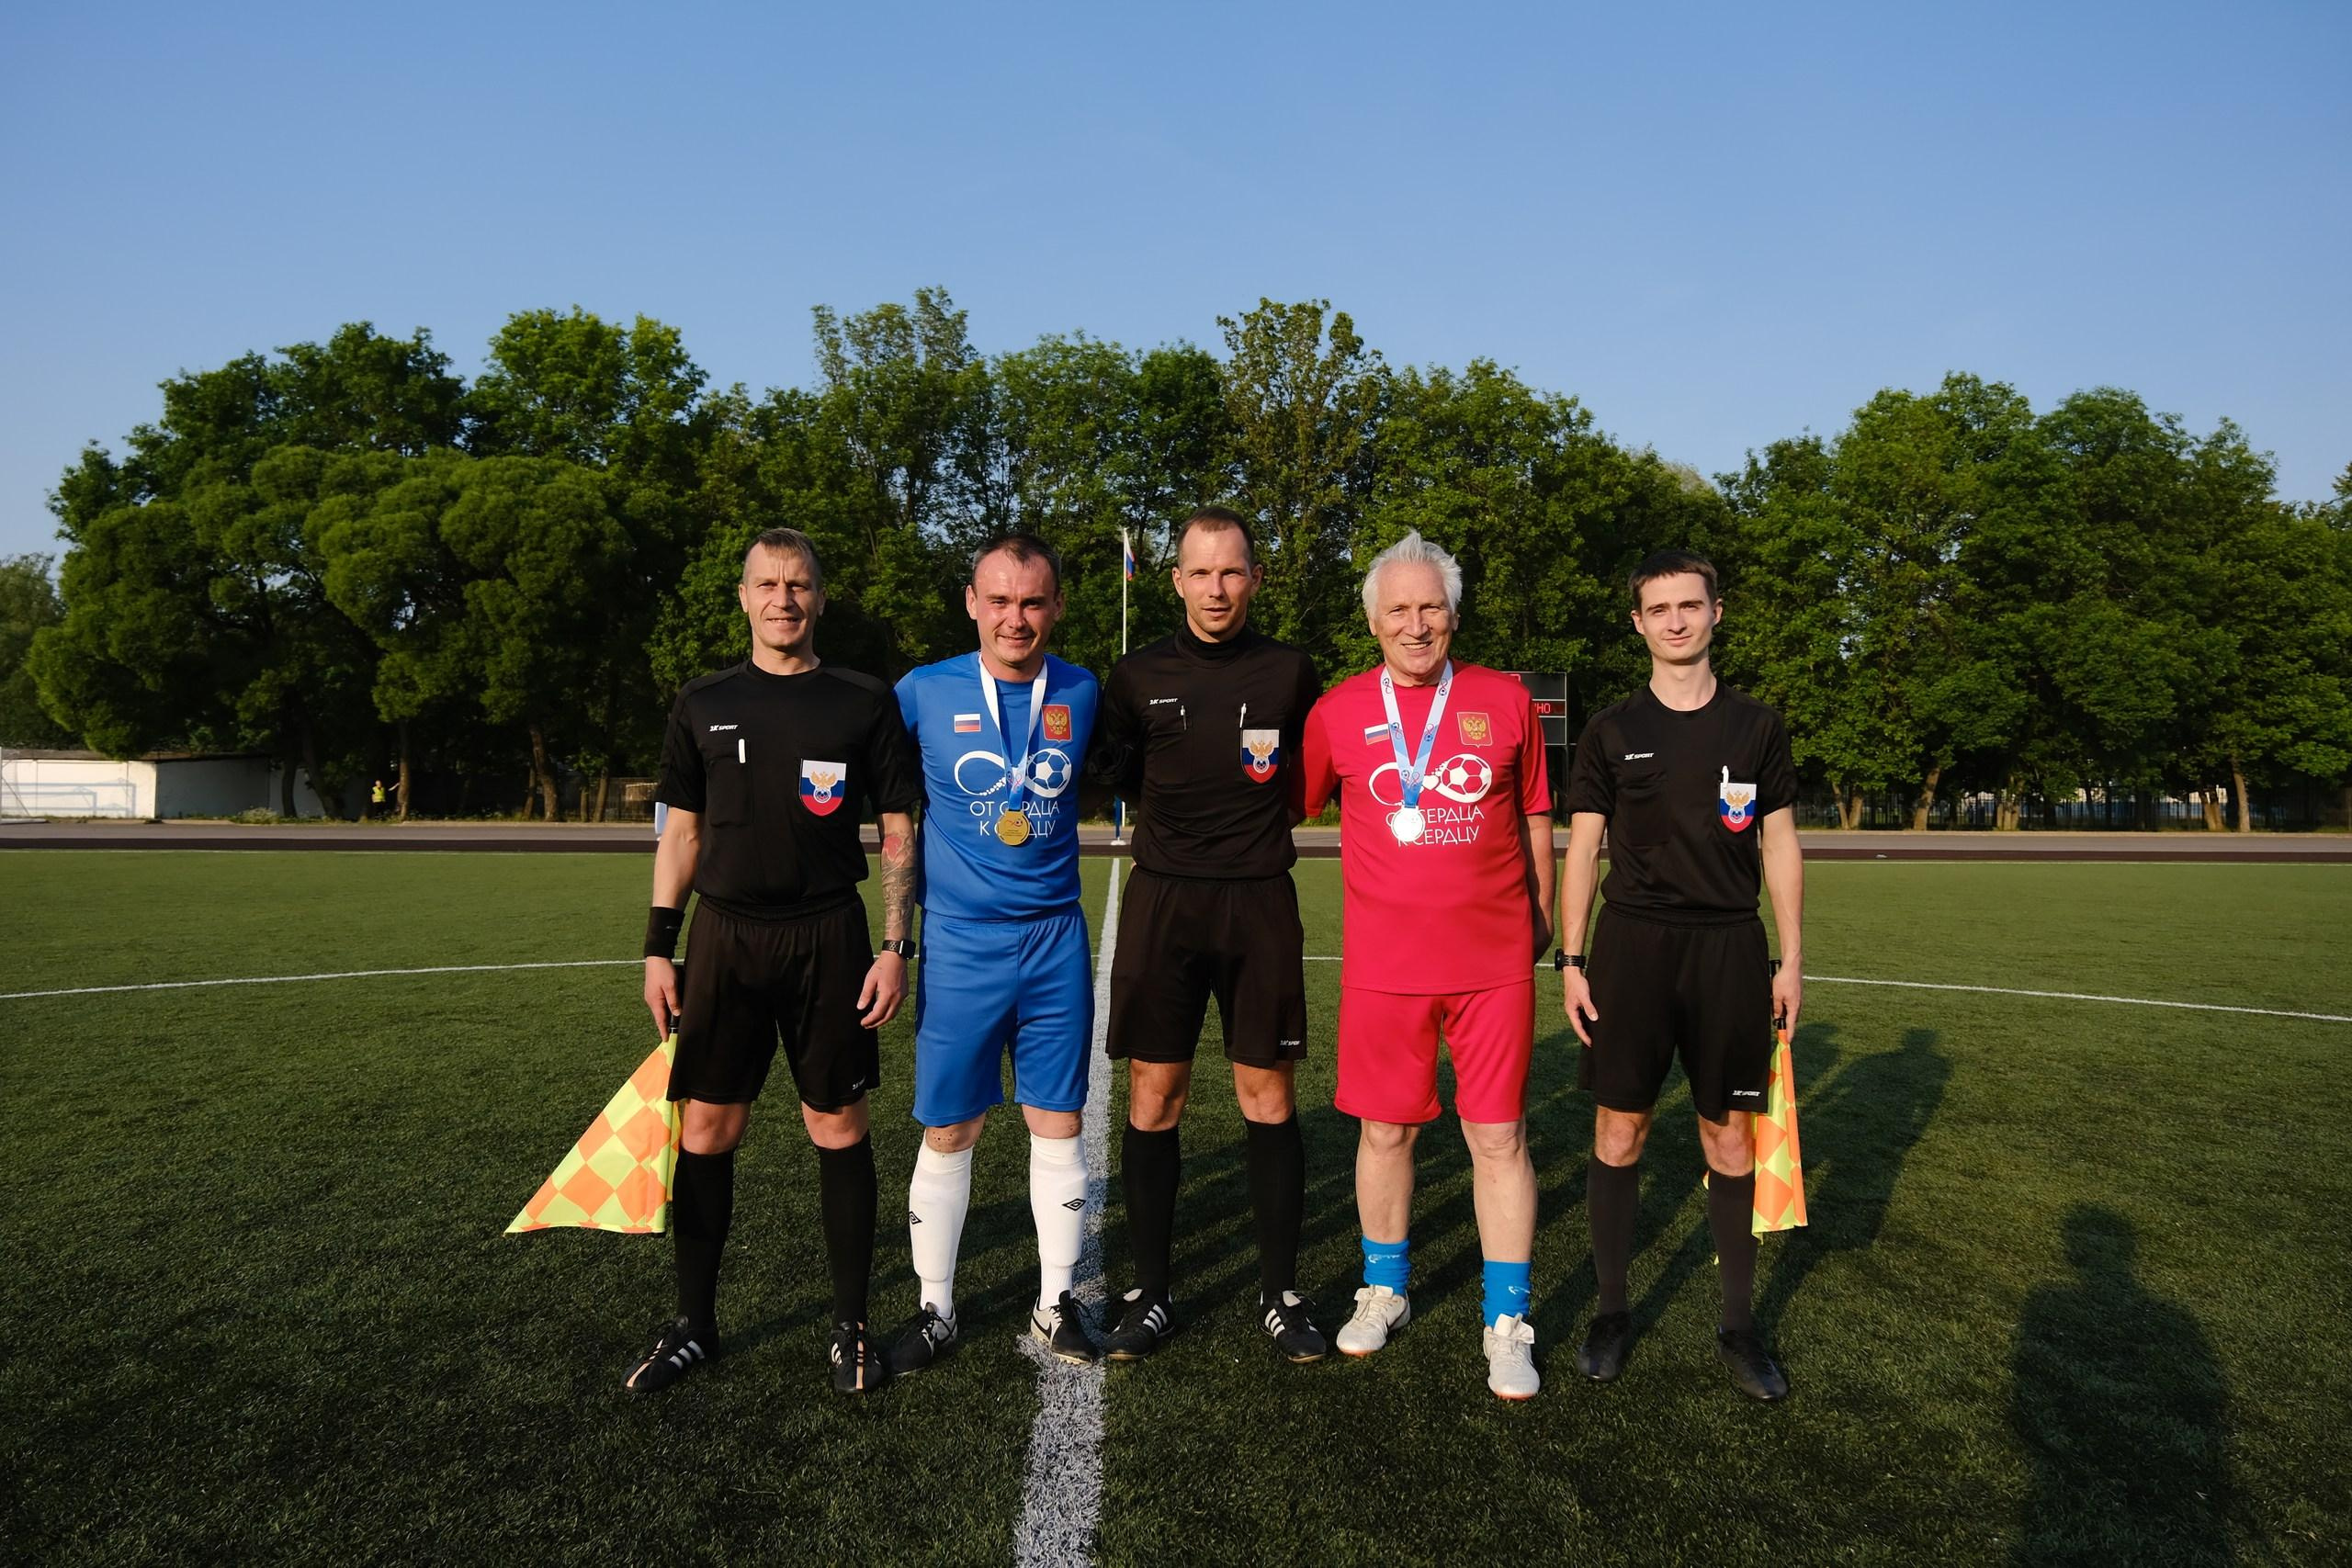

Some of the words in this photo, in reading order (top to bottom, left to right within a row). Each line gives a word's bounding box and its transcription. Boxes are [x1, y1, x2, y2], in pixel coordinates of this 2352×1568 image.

[1534, 703, 1551, 714] НО
[969, 800, 995, 817] ОТ
[999, 800, 1060, 818] СРДЦА
[979, 820, 990, 836] К
